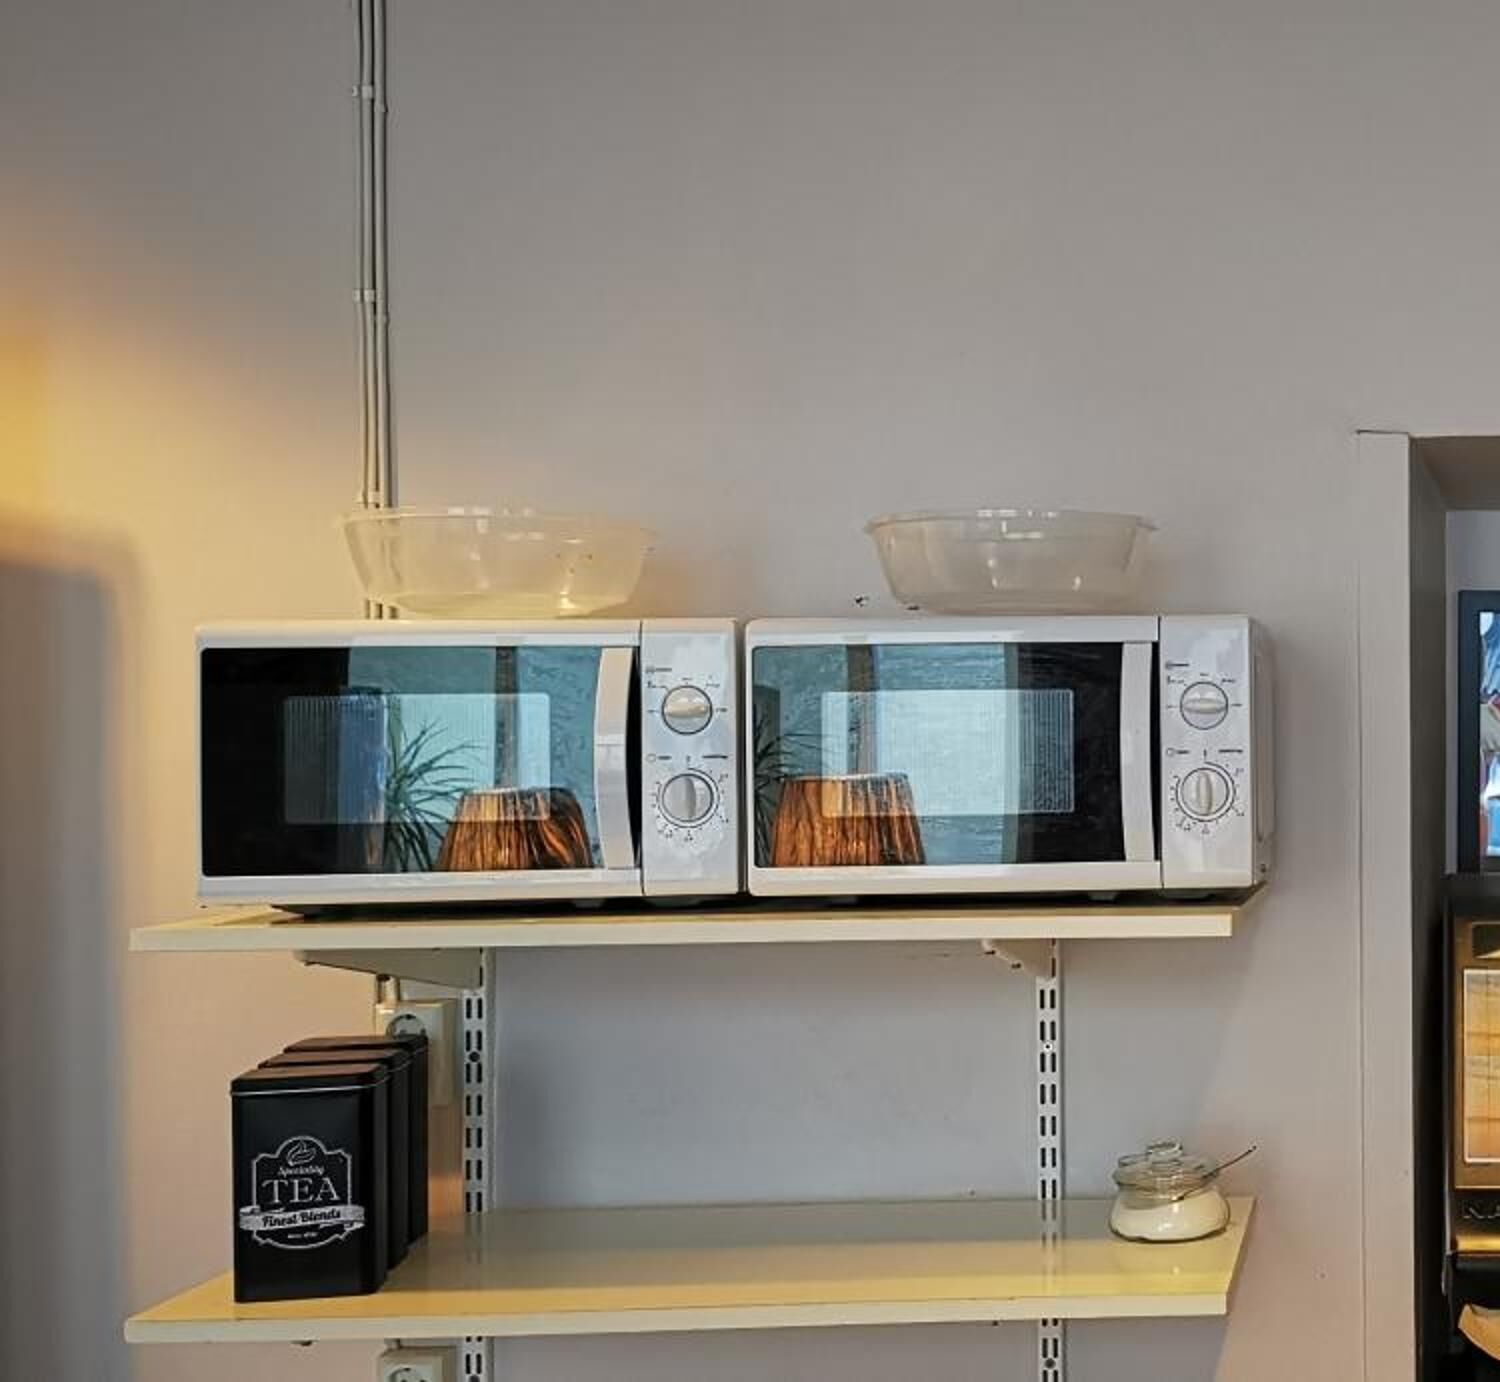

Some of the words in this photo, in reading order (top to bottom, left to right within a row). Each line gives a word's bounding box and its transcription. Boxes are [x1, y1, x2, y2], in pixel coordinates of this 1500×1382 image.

[261, 1177, 341, 1203] TEA
[262, 1213, 297, 1227] Finest
[300, 1208, 341, 1222] Blends
